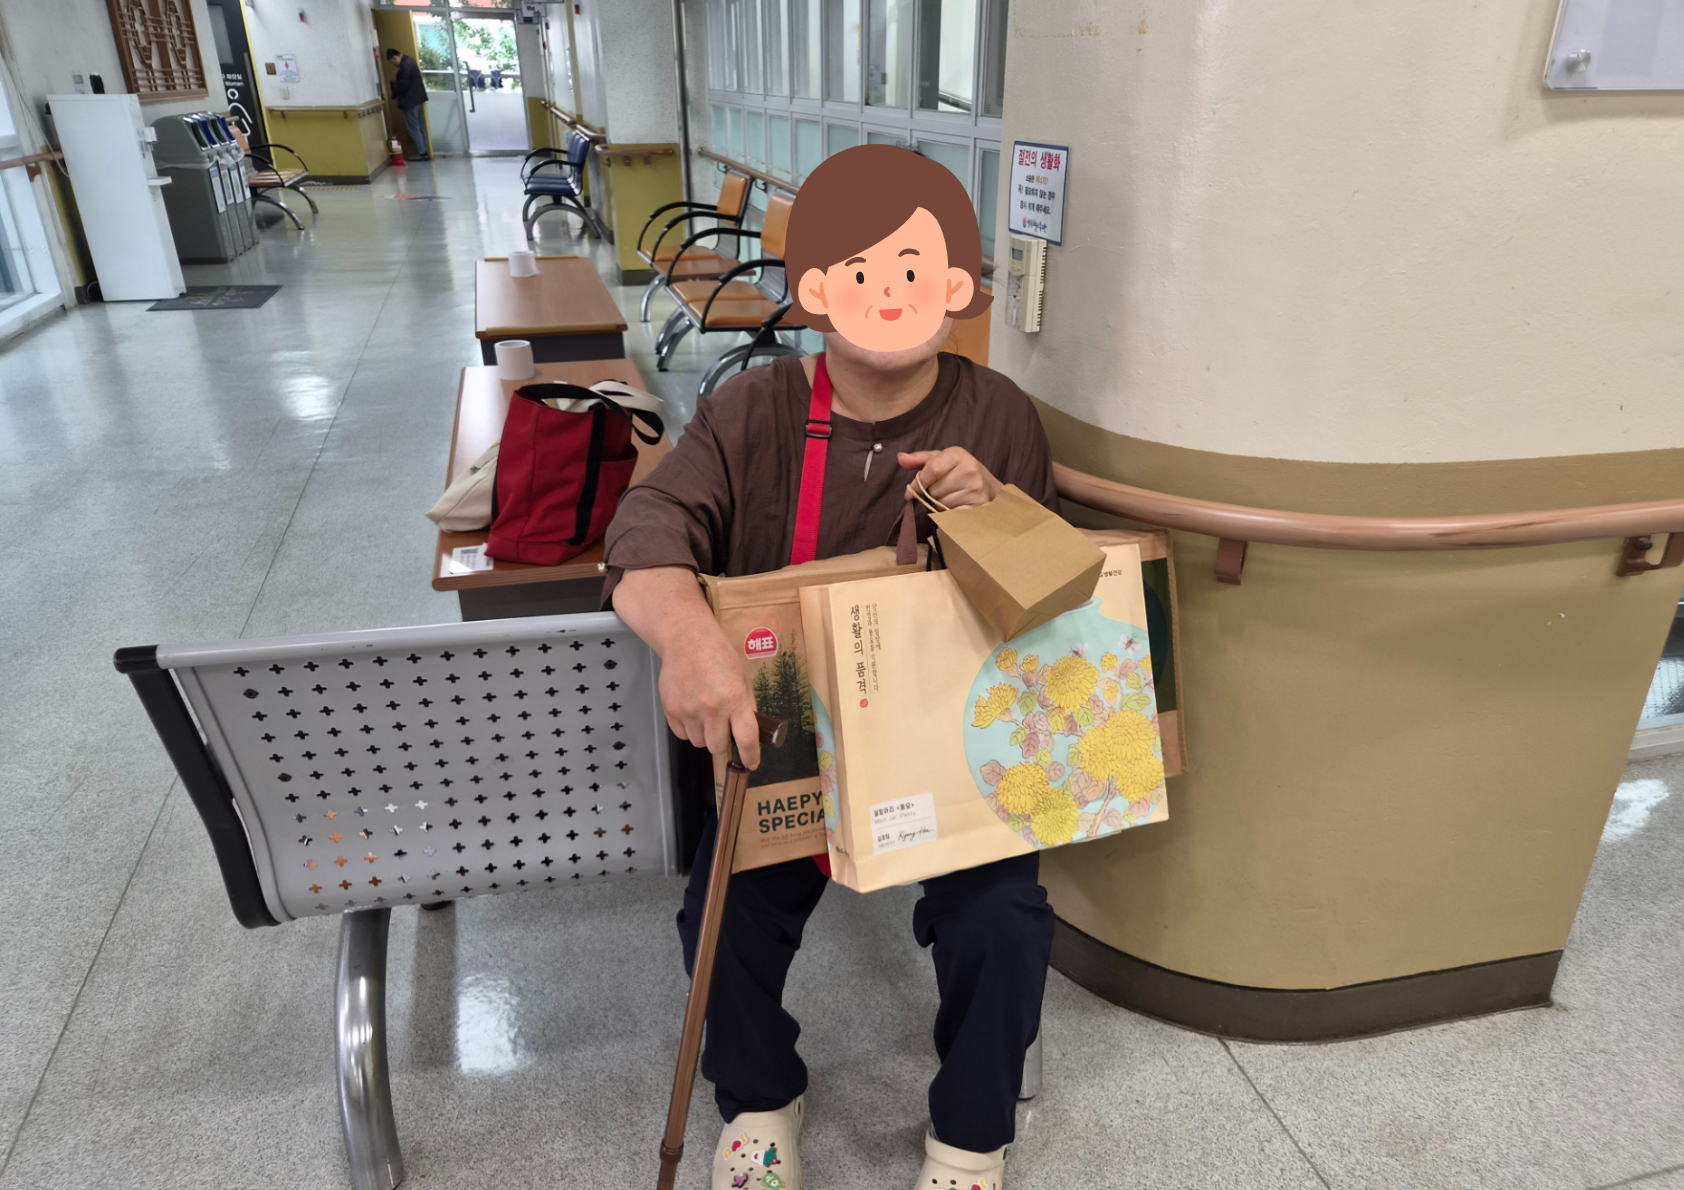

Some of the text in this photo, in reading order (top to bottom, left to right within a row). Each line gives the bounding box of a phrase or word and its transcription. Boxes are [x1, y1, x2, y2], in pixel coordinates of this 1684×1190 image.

[1019, 149, 1061, 172] 절전의 생활화
[748, 636, 773, 651] 해표
[851, 604, 866, 694] 생활의 품격
[758, 791, 822, 816] HAEPY
